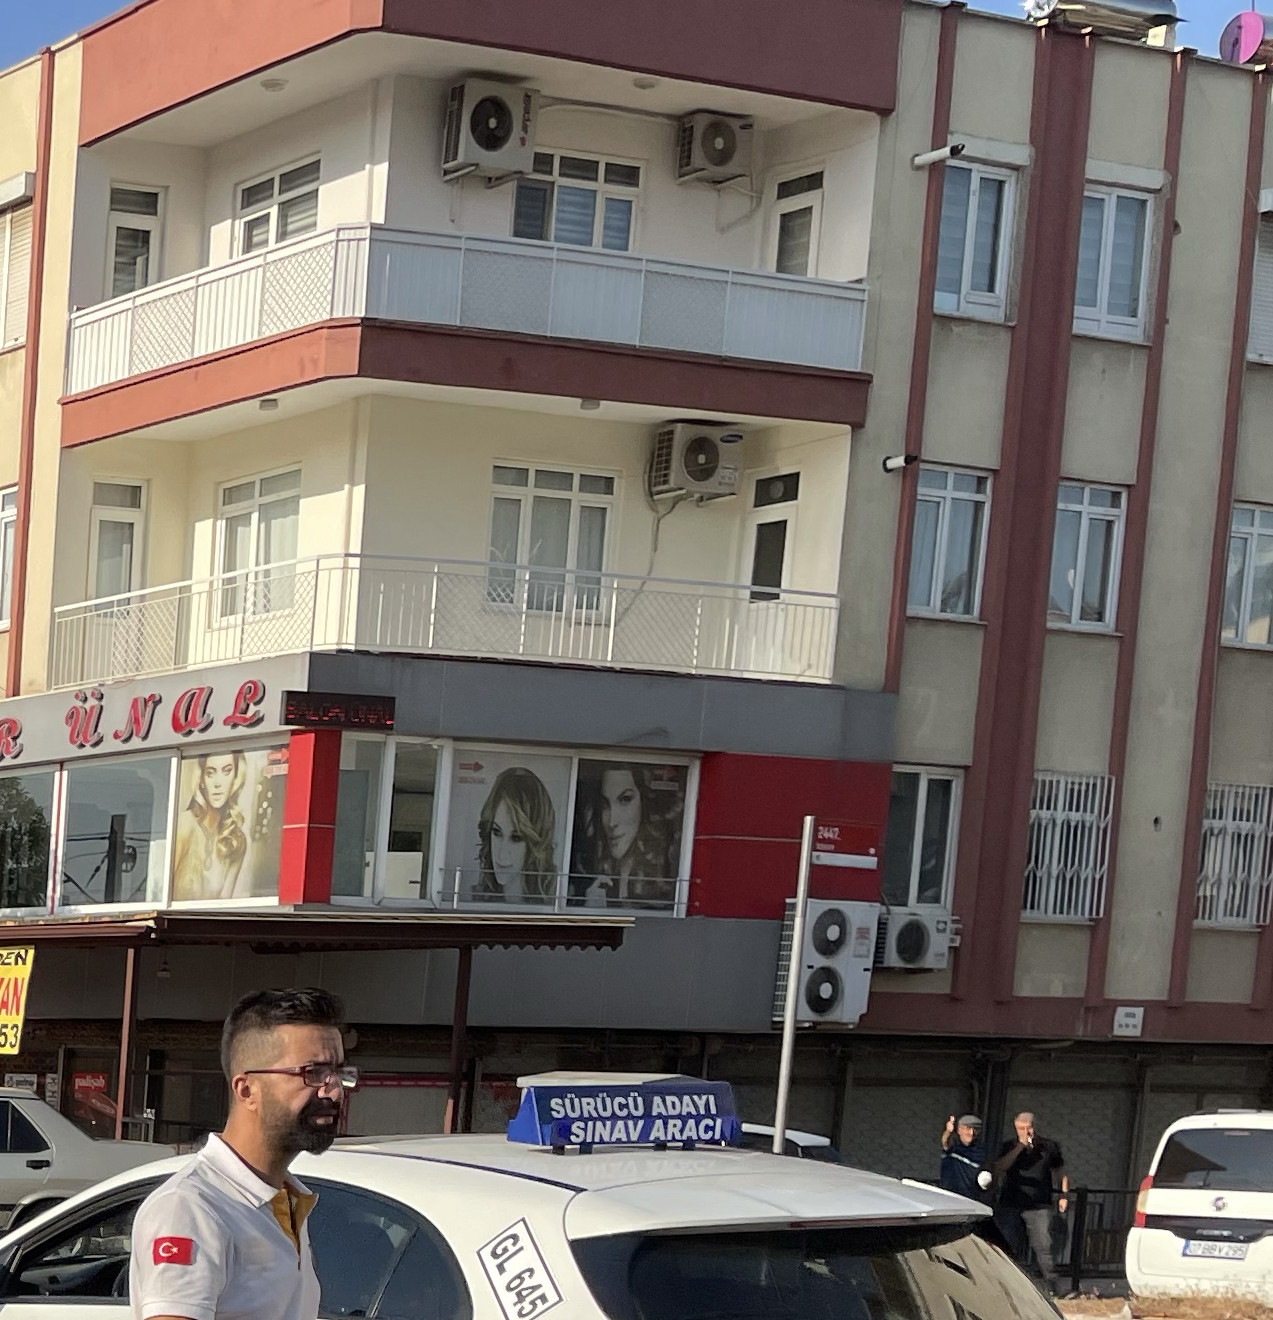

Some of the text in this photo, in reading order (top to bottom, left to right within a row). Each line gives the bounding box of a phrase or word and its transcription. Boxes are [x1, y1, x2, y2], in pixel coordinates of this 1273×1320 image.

[65, 688, 266, 748] ÜNAL
[550, 1092, 717, 1119] SÜRÜCÜ ADAYI
[570, 1118, 722, 1143] SINAV ARACI
[490, 1233, 549, 1318] GL 645
